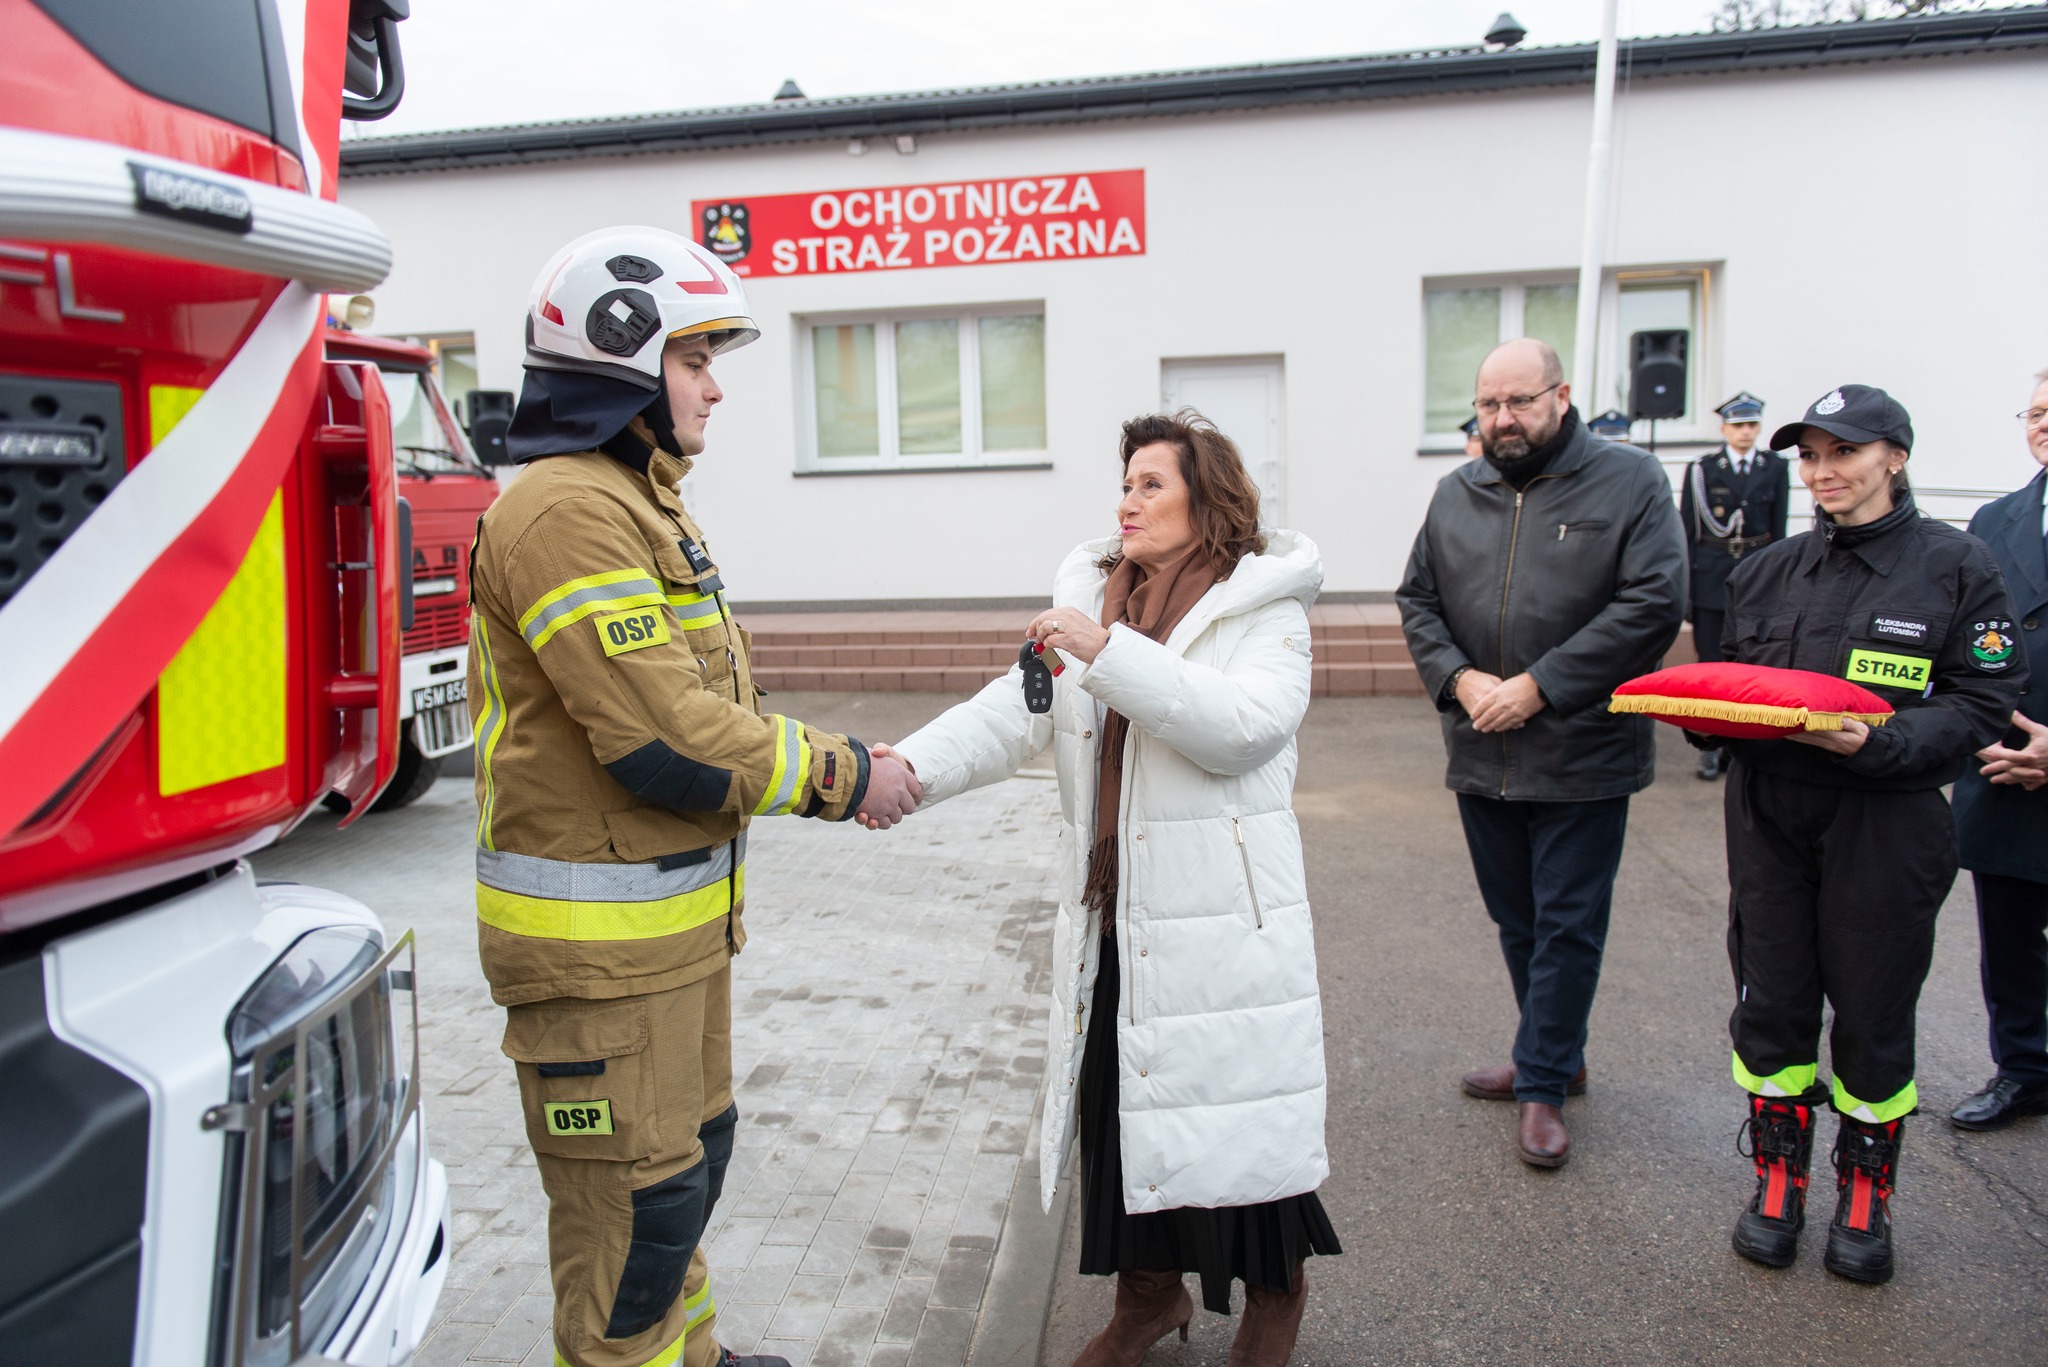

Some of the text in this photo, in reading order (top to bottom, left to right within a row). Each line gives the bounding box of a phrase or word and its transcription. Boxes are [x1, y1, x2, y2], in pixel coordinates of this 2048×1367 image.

[810, 176, 1101, 230] OCHOTNICZA
[771, 216, 1142, 274] STRAŻ POŻARNA
[606, 614, 657, 646] OSP
[1875, 618, 1927, 631] ALEKSANDRA
[1878, 626, 1920, 638] LUTOMSKA
[414, 685, 446, 712] WSM
[553, 1108, 601, 1130] OSP
